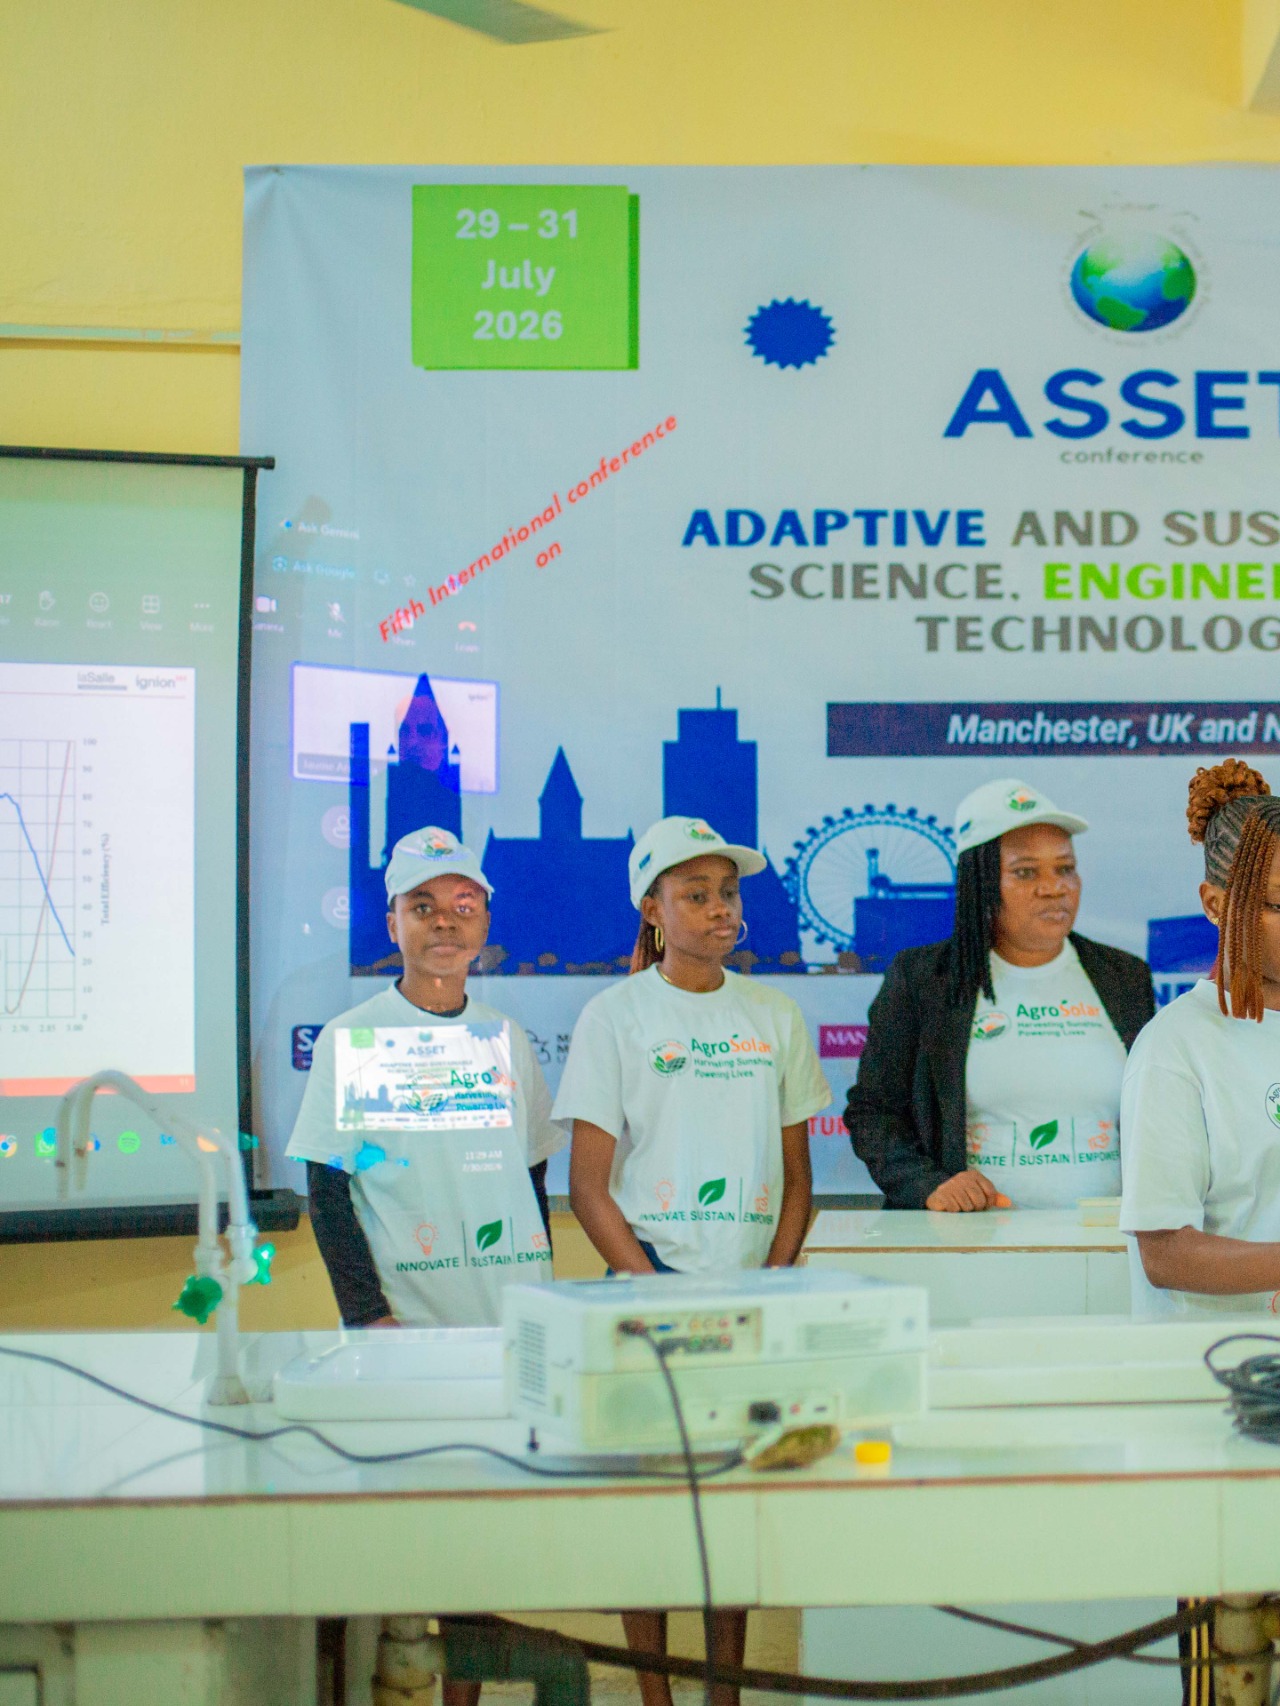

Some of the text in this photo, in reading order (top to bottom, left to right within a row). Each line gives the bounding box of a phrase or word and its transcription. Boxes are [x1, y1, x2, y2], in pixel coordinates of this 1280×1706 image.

[455, 208, 500, 239] 29
[537, 208, 579, 239] 31
[481, 259, 556, 297] July
[472, 310, 563, 341] 2026
[1059, 447, 1204, 465] conference
[377, 414, 678, 642] Fifth International conference
[681, 508, 987, 548] ADAPTIVE
[1010, 509, 1140, 548] AND
[534, 541, 563, 569] on
[946, 711, 1139, 750] Manchester,
[1146, 712, 1196, 744] UK
[1198, 711, 1257, 744] and
[1016, 1000, 1100, 1021] AgroSolar
[407, 1045, 447, 1056] ASSET
[691, 1034, 773, 1058] AgroSolar
[968, 1153, 1008, 1167] OVATE
[1018, 1152, 1071, 1167] SUSTAIN
[638, 1210, 687, 1223] INNOVATE
[689, 1210, 736, 1223] SUSTAIN
[395, 1256, 460, 1273] INNOVATE
